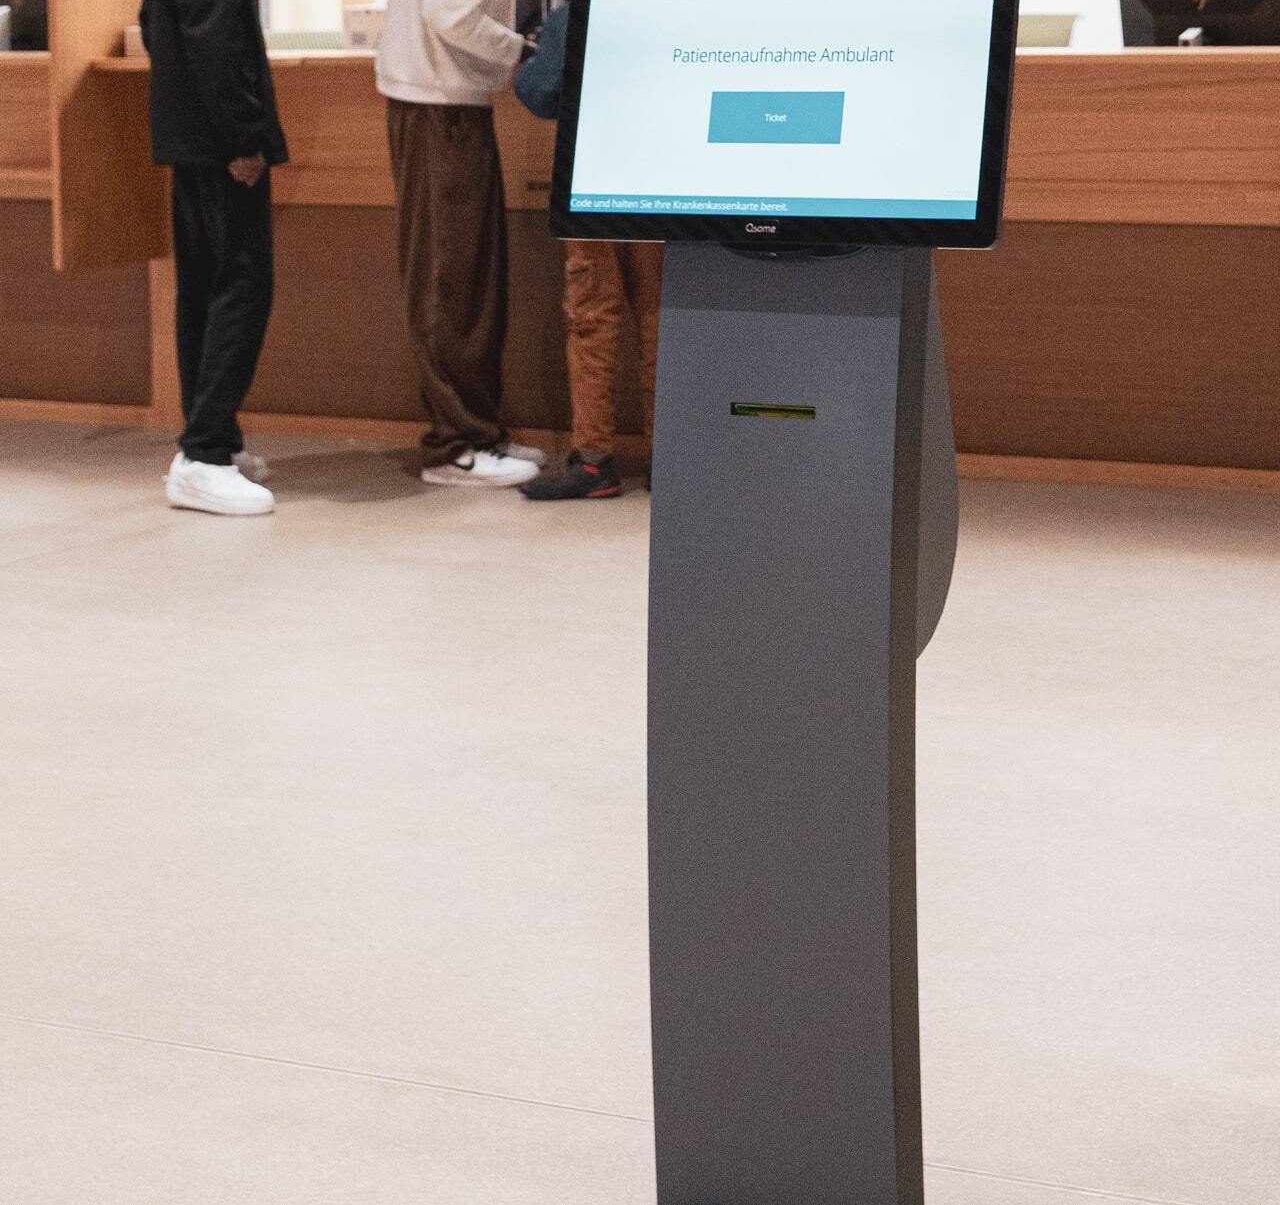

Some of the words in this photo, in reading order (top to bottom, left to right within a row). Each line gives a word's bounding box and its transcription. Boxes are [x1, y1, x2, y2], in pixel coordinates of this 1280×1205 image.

[672, 47, 816, 63] Patientenaufnahme
[820, 46, 895, 63] Ambulant
[764, 113, 787, 122] Ticket
[570, 199, 592, 208] Code
[594, 199, 610, 208] und
[612, 199, 638, 209] halten
[640, 200, 653, 209] Sie
[655, 200, 671, 210] Ihre
[673, 200, 758, 211] Krankenkassenkarte
